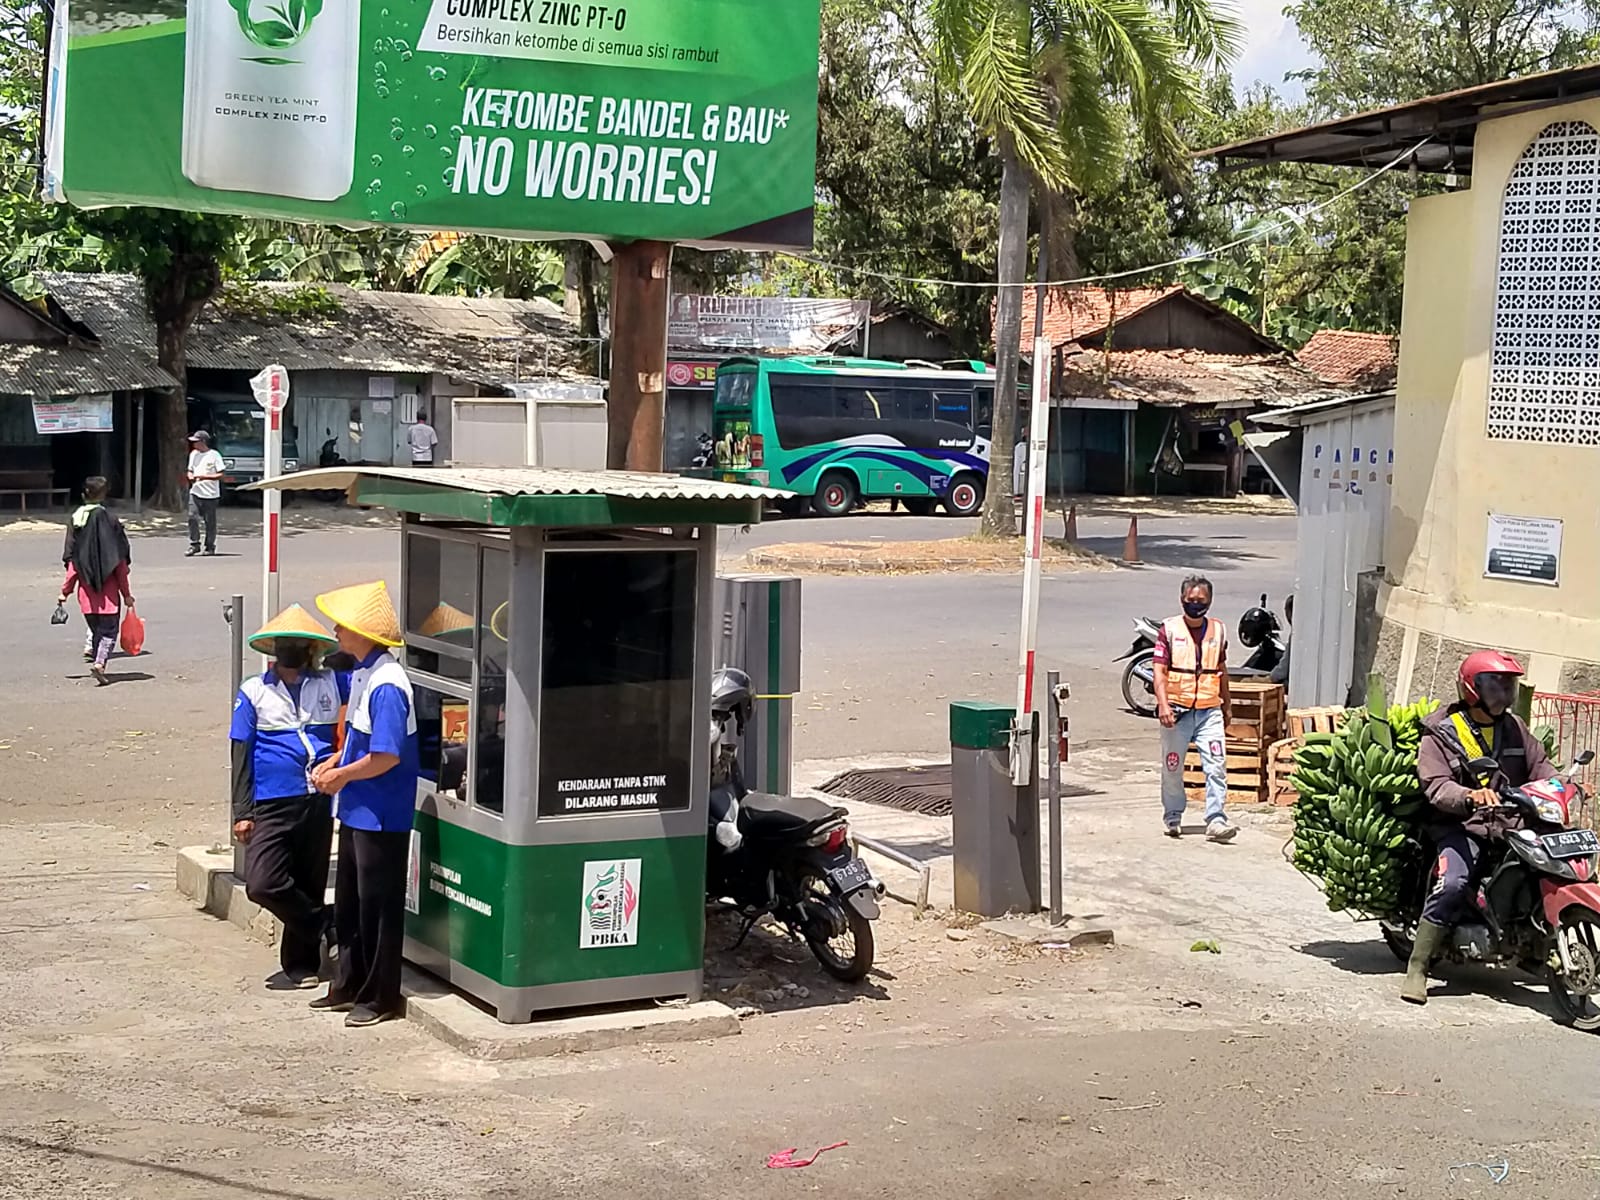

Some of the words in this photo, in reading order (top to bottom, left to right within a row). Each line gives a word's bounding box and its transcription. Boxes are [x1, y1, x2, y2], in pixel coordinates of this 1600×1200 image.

[446, 0, 533, 23] COMPLEX
[538, 1, 582, 28] ZINC
[437, 23, 511, 46] Bersihkan
[515, 31, 578, 52] ketombe
[582, 37, 595, 53] di
[597, 39, 643, 57] semua
[647, 42, 669, 59] sisi
[671, 45, 720, 63] rambut
[225, 92, 264, 103] GREEN
[267, 95, 289, 105] TEA
[293, 98, 320, 107] MINT
[214, 106, 270, 120] COMPLEX
[272, 112, 300, 122] ZINC
[461, 87, 595, 135] KETOMBE
[596, 97, 696, 141] BANDEL
[701, 104, 721, 142] &
[451, 135, 515, 197] NO
[524, 138, 719, 206] WORRIES!
[557, 778, 612, 792] KENDARAAN
[613, 776, 641, 789] TANPA
[642, 774, 667, 787] STNK
[564, 795, 619, 809] DILARANG
[620, 793, 658, 806] MASUK
[590, 932, 629, 946] PBKA
